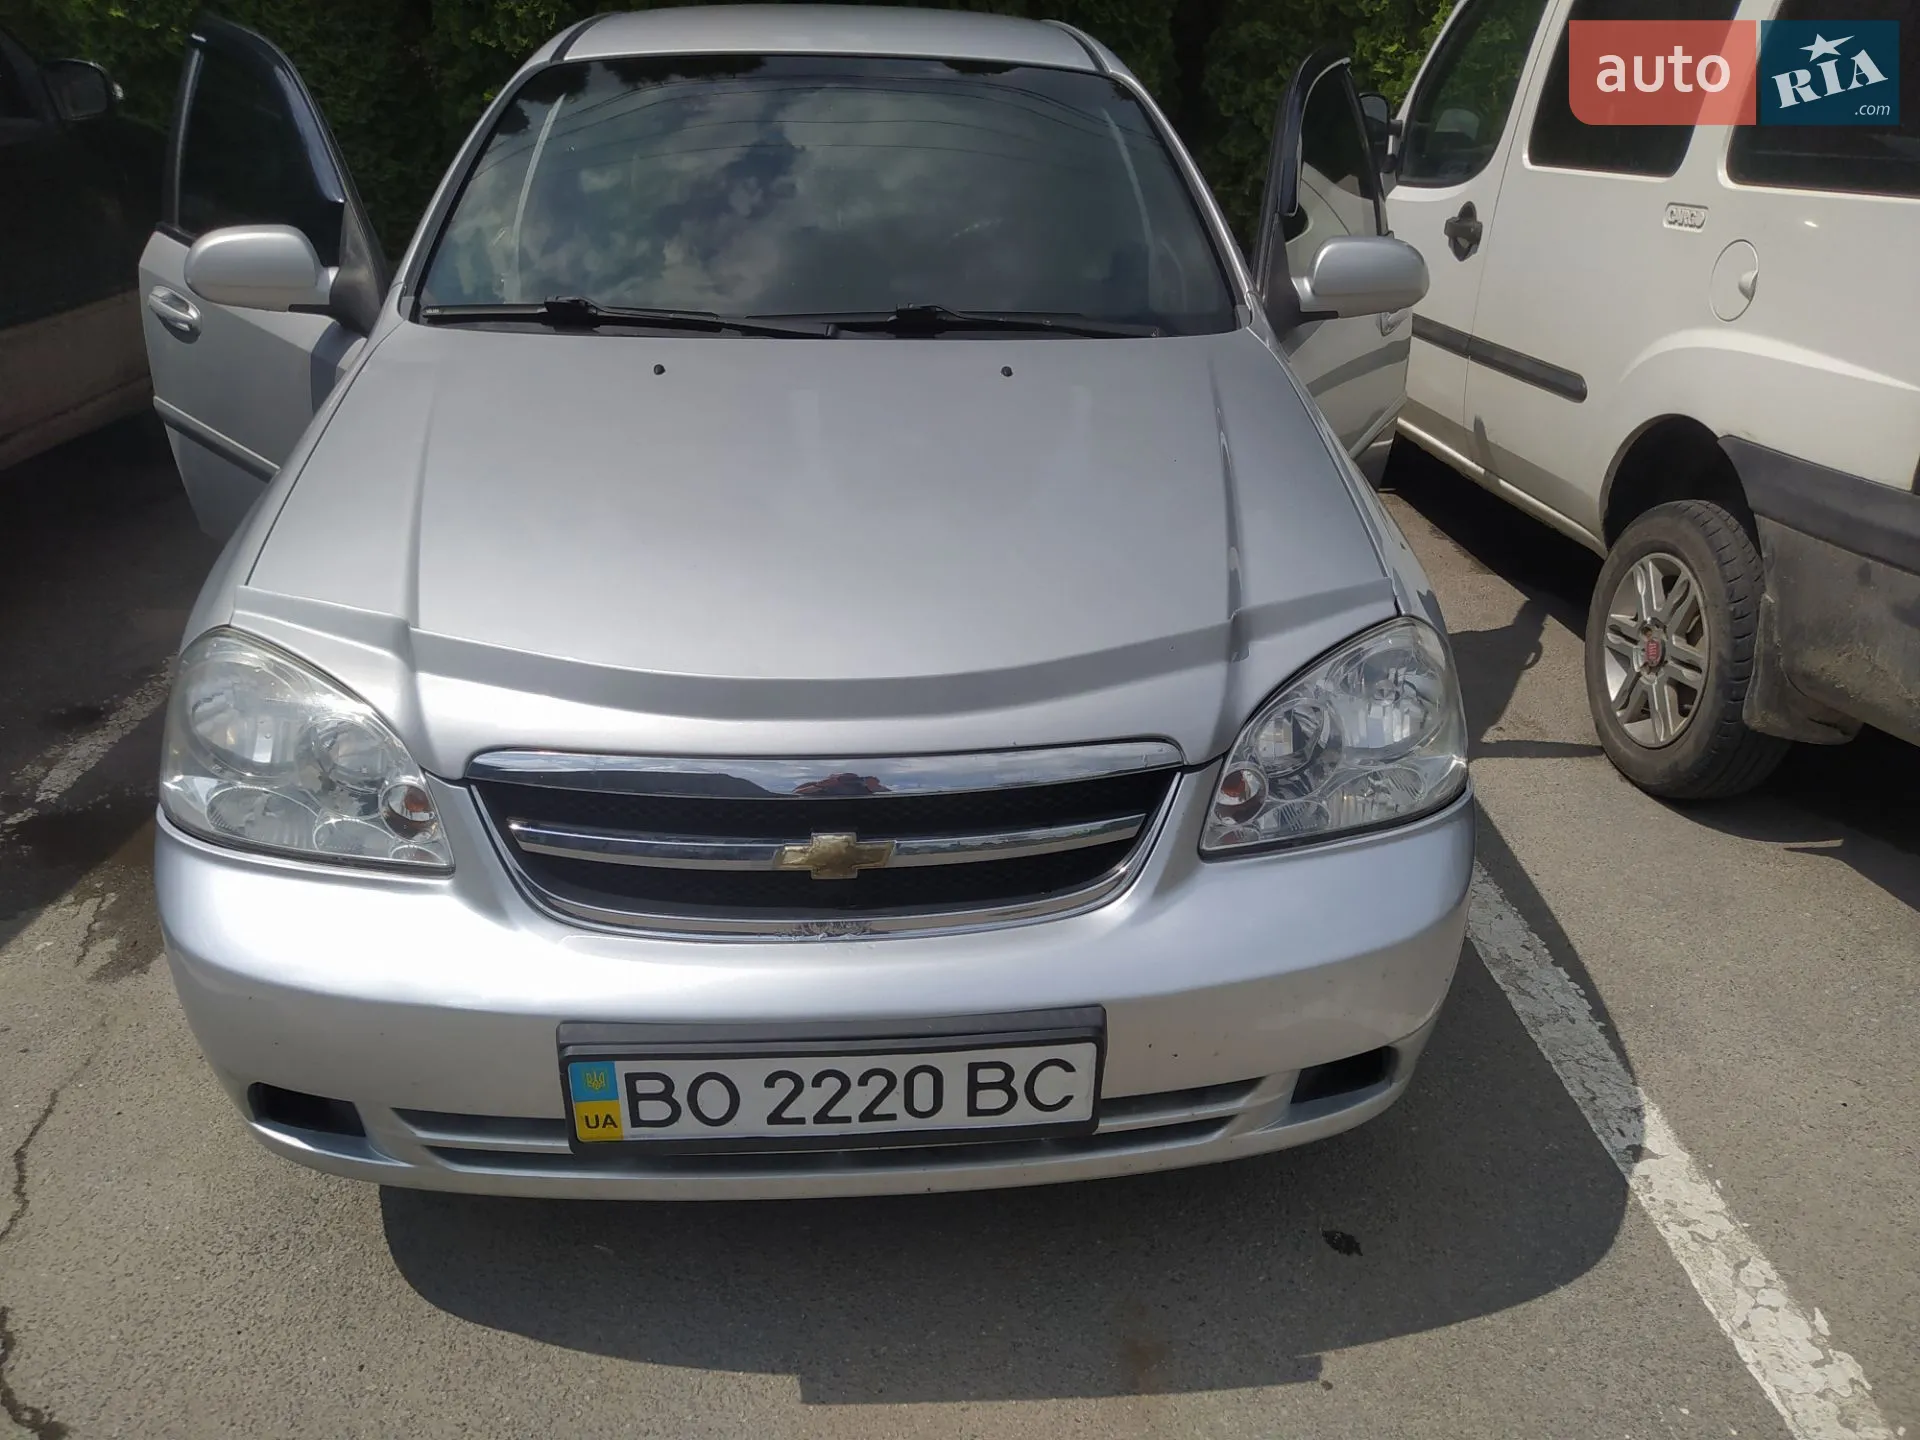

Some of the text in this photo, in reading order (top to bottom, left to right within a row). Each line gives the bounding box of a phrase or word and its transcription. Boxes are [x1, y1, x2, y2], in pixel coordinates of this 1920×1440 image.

[1667, 206, 1705, 228] CARGO
[624, 1058, 1077, 1128] BO 2220 BC
[584, 1113, 619, 1130] UA
